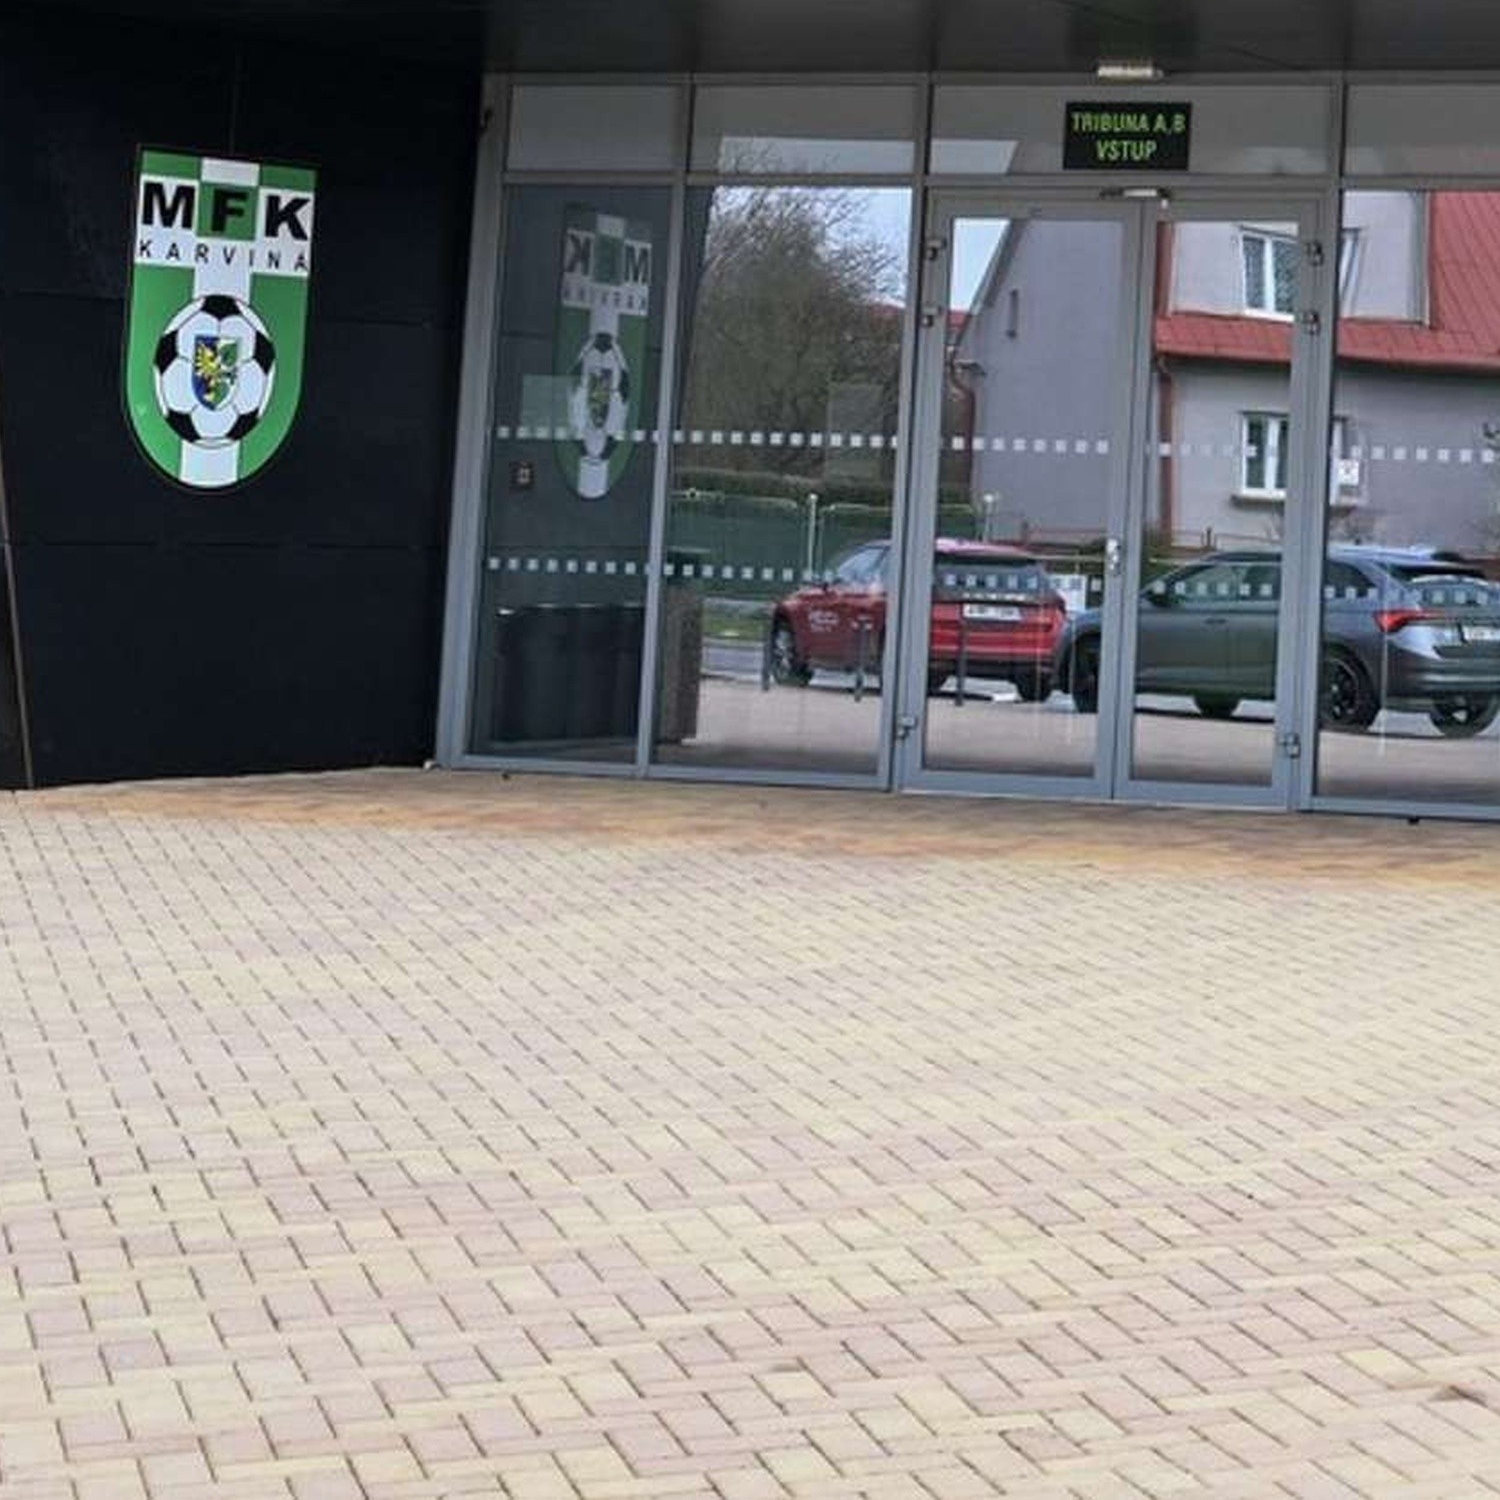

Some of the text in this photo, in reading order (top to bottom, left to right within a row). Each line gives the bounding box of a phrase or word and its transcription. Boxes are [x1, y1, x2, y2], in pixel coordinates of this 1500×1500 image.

[1071, 112, 1149, 132] TRIBUNA
[1096, 139, 1157, 161] VSTUP
[142, 182, 310, 241] MFK
